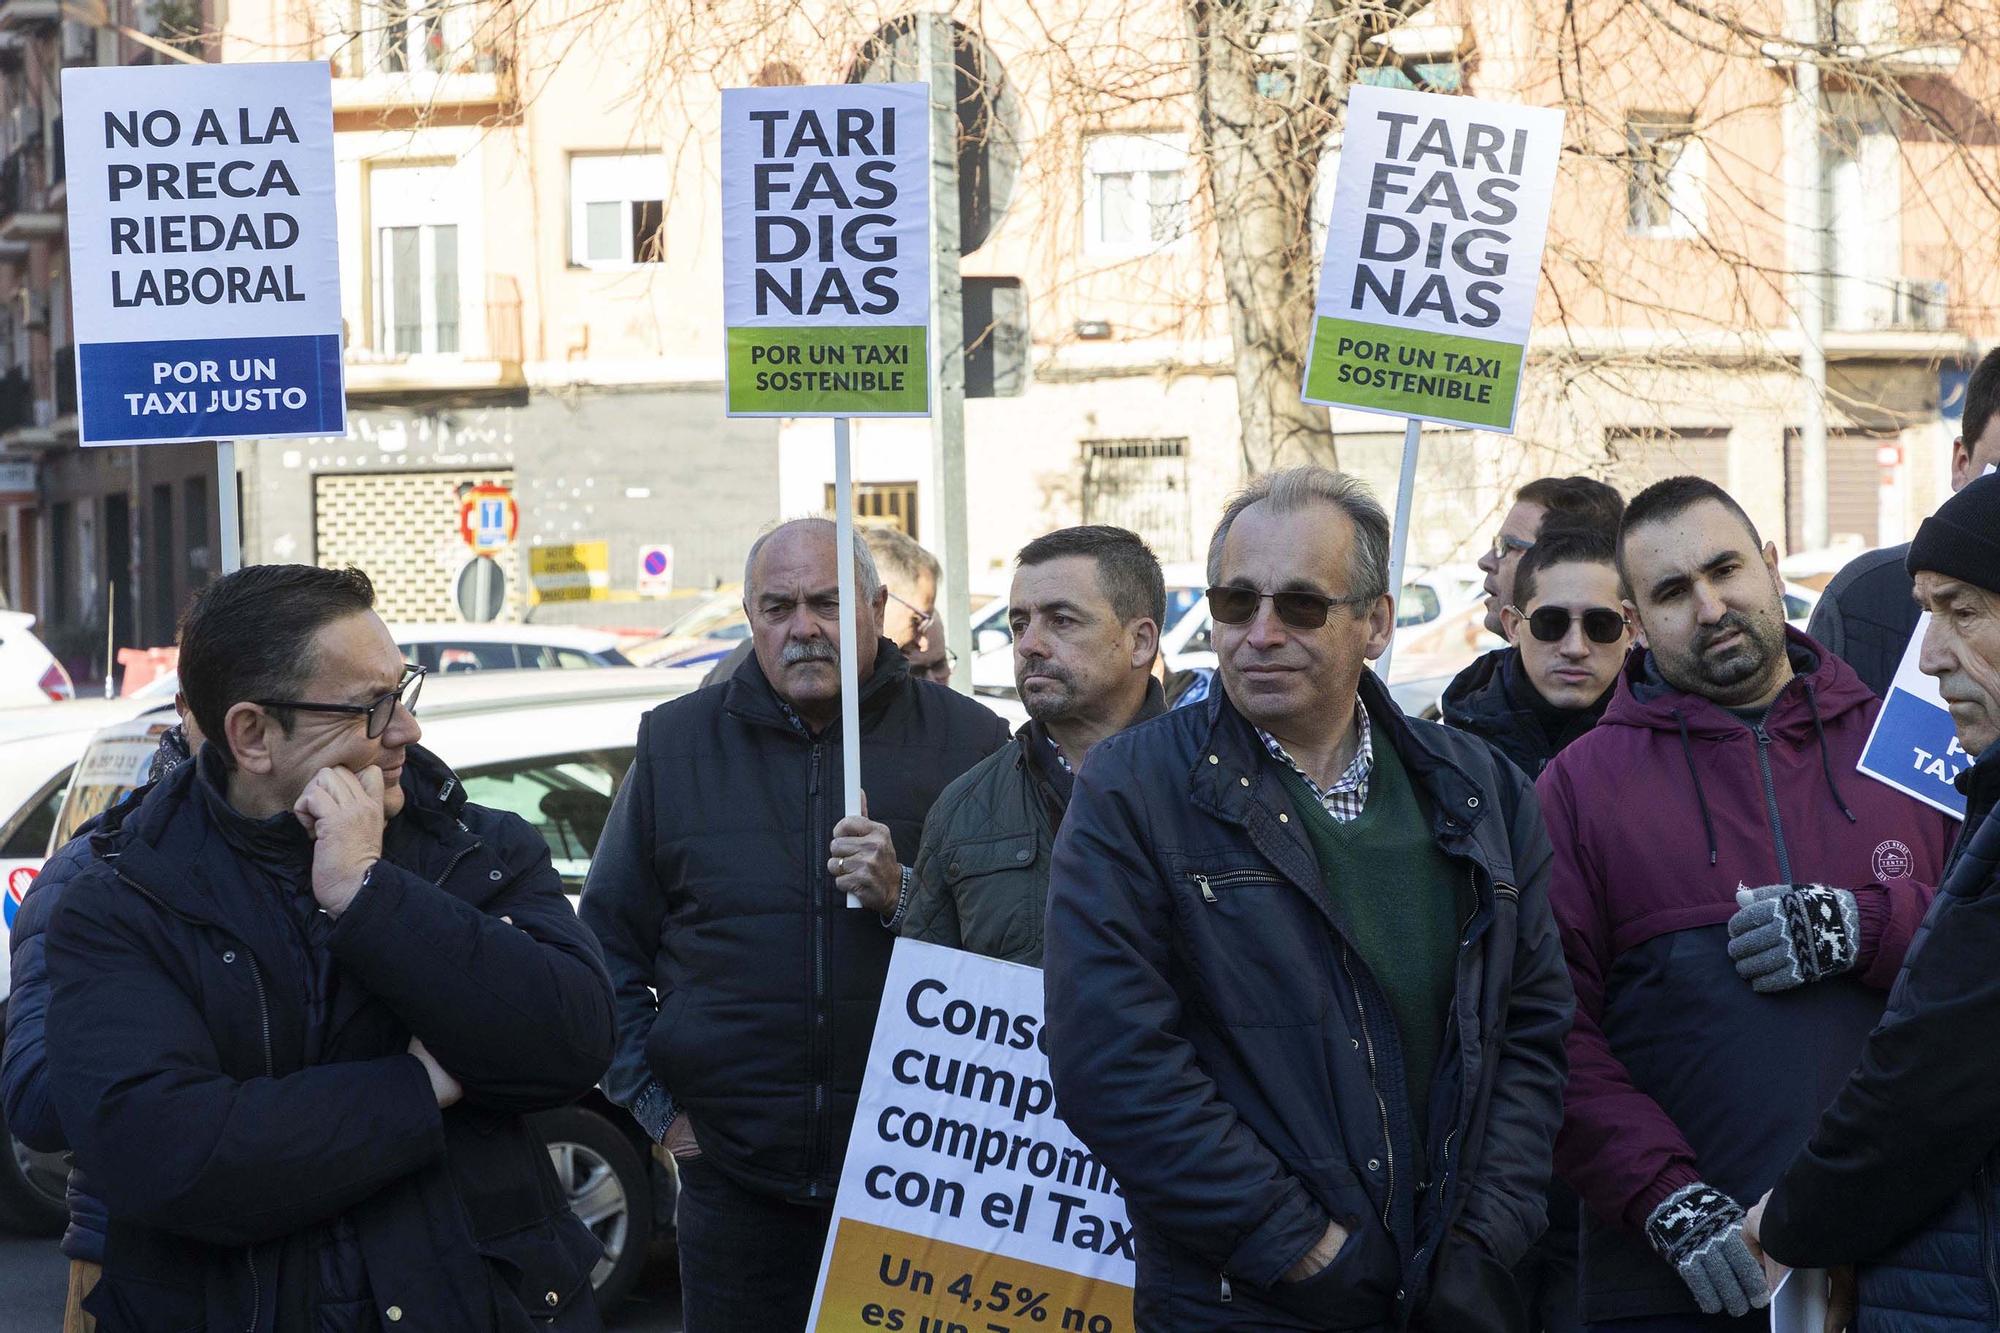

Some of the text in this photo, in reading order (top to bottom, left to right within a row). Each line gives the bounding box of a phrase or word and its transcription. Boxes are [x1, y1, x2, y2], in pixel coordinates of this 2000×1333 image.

[104, 106, 300, 149] NO A LA
[749, 107, 896, 159] TARI
[1376, 111, 1528, 177] TARI
[107, 159, 301, 202] PRECA
[753, 160, 898, 211] FAS
[1367, 162, 1520, 225] FAS
[110, 212, 300, 255] RIEDAD
[754, 213, 898, 264] DIG
[1359, 213, 1512, 277] DIG
[111, 264, 305, 308] LABORAL
[754, 266, 900, 316] NAS
[1350, 263, 1503, 328] NAS
[153, 358, 276, 385] POR UN
[751, 345, 908, 365] POR UN TAXI
[1337, 337, 1501, 379] POR UN TAXI
[123, 387, 307, 416] TAXI JUSTO
[756, 371, 904, 392] SOSTENIBLE
[1337, 363, 1493, 405] SOSTENIBLE
[891, 1048, 1062, 1123] cump
[877, 1105, 1124, 1199] compromi
[864, 1164, 965, 1219] con
[980, 1183, 1034, 1234] el
[861, 1303, 906, 1331] es
[878, 1253, 1113, 1333] Un 4,5% no
